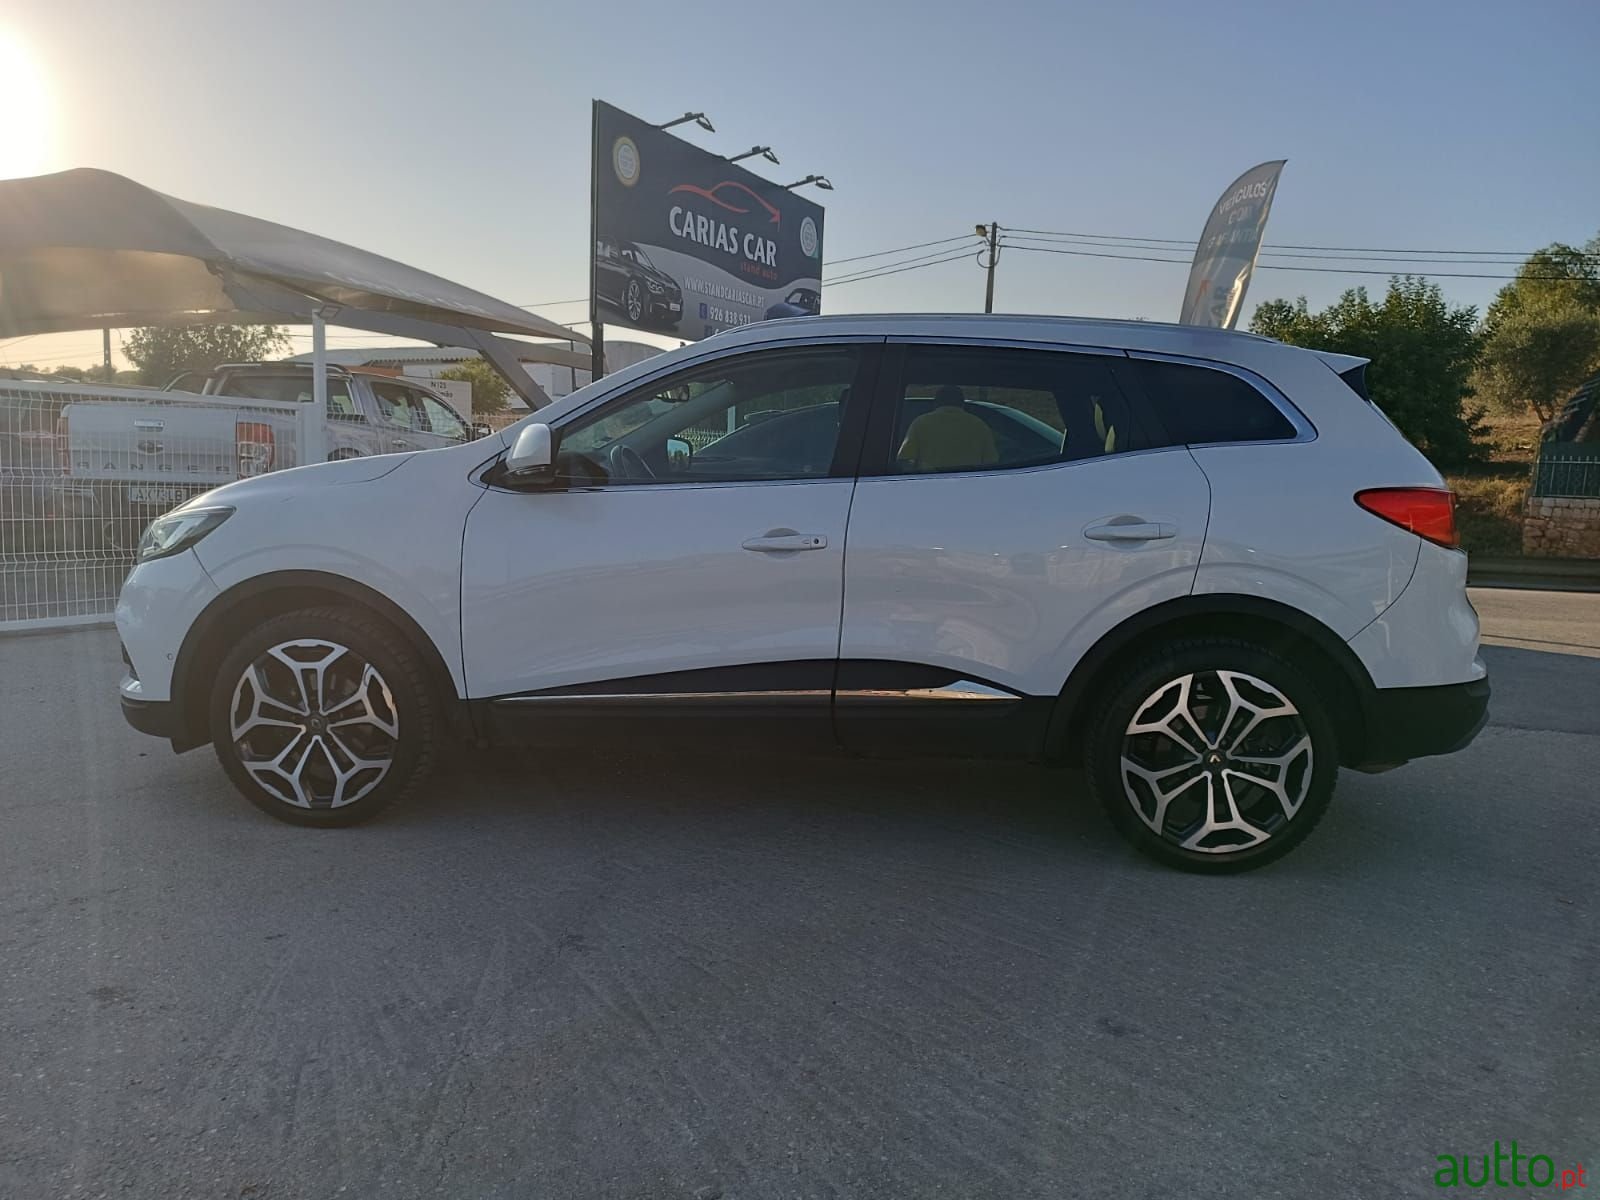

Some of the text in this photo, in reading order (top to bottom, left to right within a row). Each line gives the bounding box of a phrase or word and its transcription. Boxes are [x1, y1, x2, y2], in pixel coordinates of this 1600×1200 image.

[669, 206, 777, 267] CARIAS CAR
[709, 306, 723, 321] 926
[77, 461, 231, 475] RANGER
